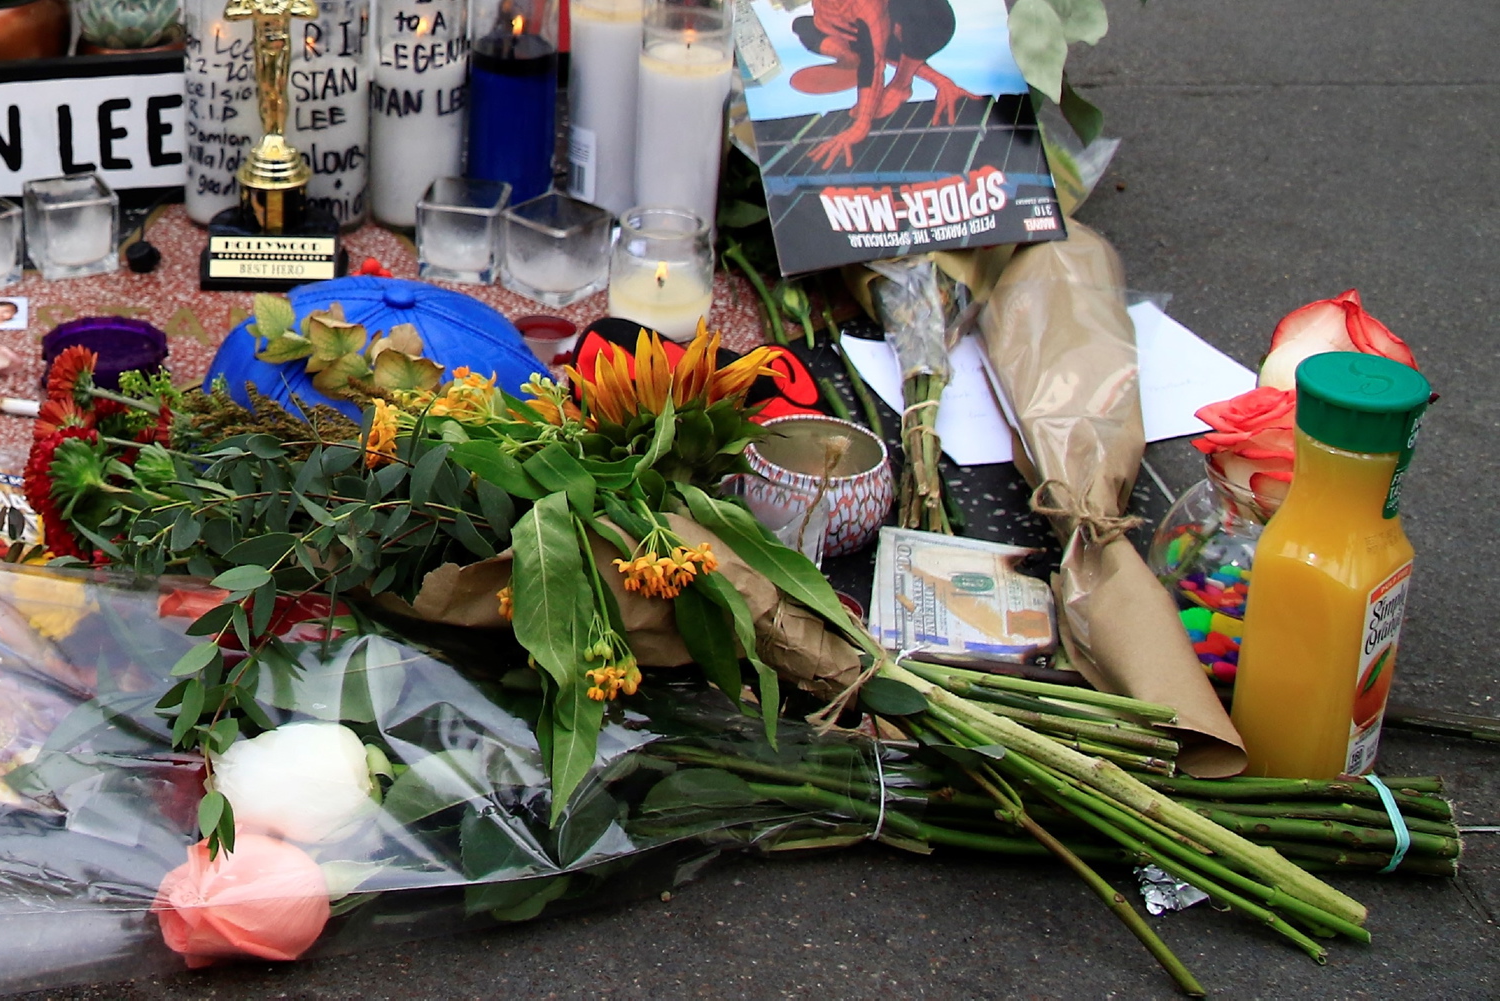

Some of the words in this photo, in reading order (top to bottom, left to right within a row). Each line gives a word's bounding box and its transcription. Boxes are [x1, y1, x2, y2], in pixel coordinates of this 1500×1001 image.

[394, 11, 420, 32] to
[431, 11, 446, 35] A
[291, 67, 358, 102] STAN
[295, 107, 346, 131] LEE
[58, 95, 183, 174] LEE
[821, 168, 1006, 232] SPIDER-MAN
[1034, 204, 1052, 216] 310
[931, 220, 967, 242] PARKER:
[969, 214, 996, 233] PETER
[1024, 217, 1056, 231] MARVEL
[225, 241, 320, 251] HOLLYWOOD
[848, 231, 911, 248] SPECTACULAR
[911, 230, 930, 243] THE
[240, 264, 267, 274] BEST
[271, 264, 304, 275] HERO
